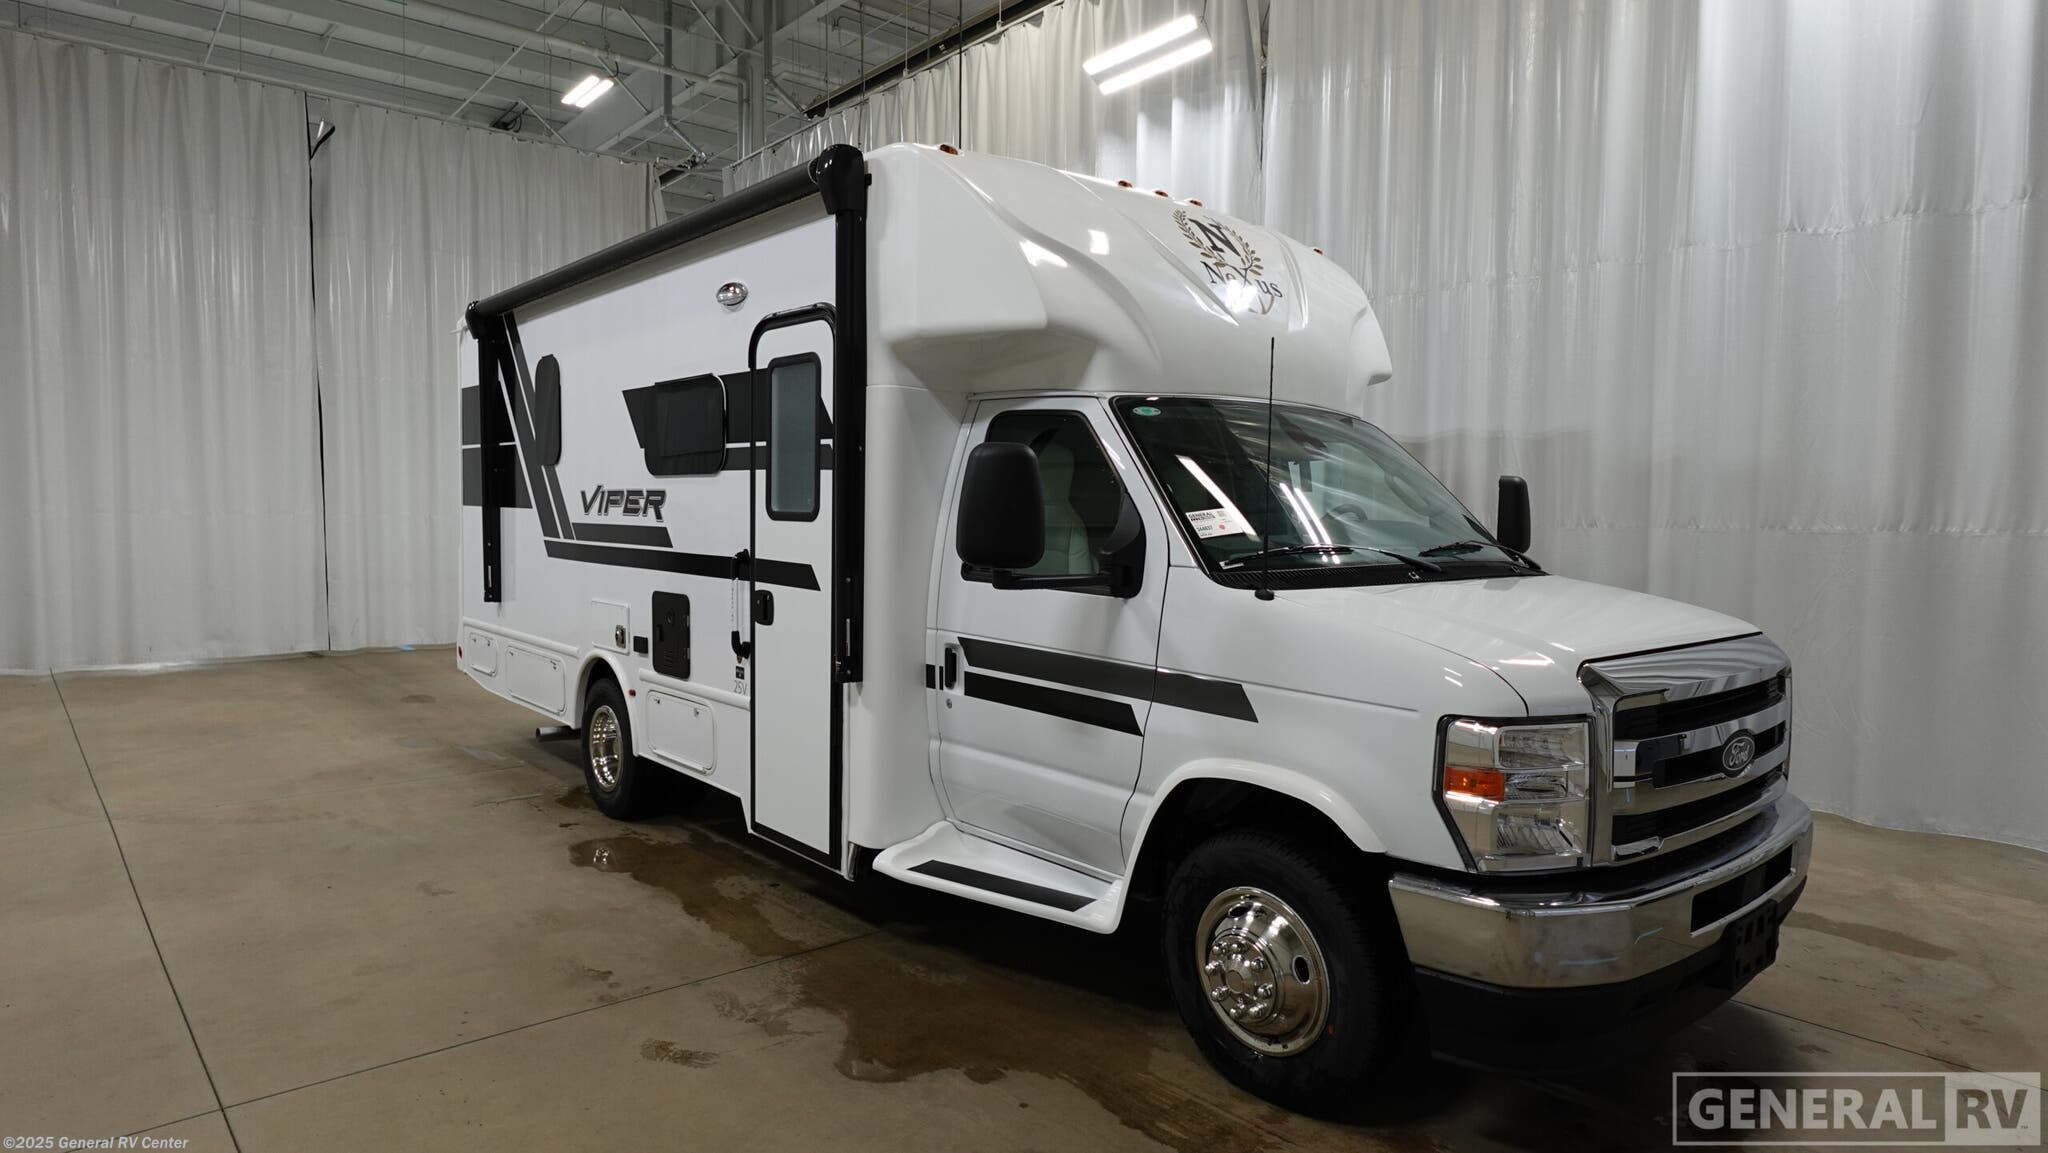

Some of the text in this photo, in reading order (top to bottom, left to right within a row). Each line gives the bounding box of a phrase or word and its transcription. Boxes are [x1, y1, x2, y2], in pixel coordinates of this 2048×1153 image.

[1188, 218, 1242, 257] N
[580, 485, 666, 523] VIPER
[1730, 742, 1750, 767] Ford
